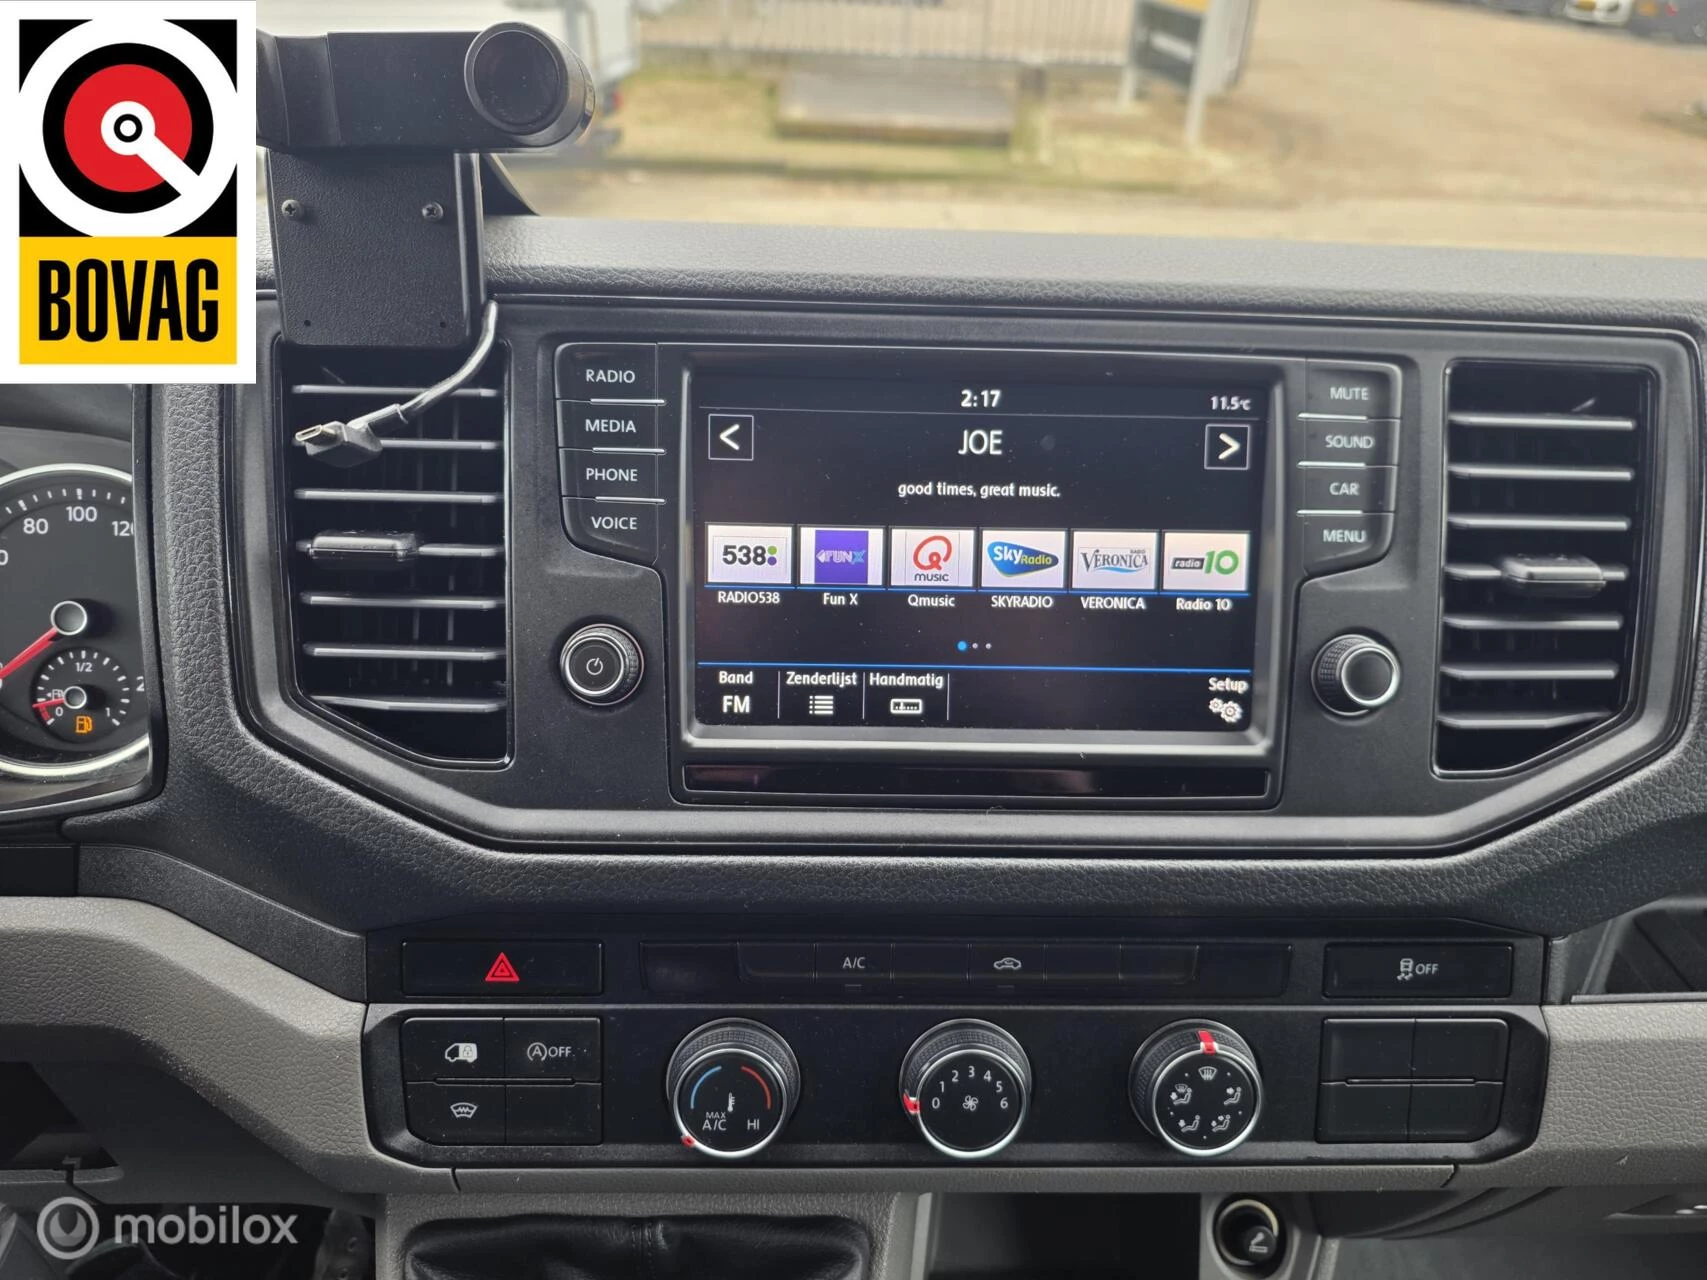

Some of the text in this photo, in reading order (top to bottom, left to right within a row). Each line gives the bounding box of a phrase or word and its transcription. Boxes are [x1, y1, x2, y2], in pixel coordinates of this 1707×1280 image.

[585, 369, 636, 383] RADIO
[960, 389, 1001, 408] 2:17
[1330, 387, 1369, 400] MUTE
[585, 419, 637, 433] MEDIA
[957, 429, 1003, 456] JOE
[1325, 435, 1375, 449] SOUND
[586, 468, 638, 482] PHONE
[897, 482, 1061, 500] good times, great music.
[1329, 482, 1360, 496] CAR
[66, 506, 98, 522] 100
[23, 518, 49, 535] 80
[591, 517, 638, 530] VOICE
[1323, 529, 1367, 543] MENU
[722, 544, 767, 565] 538
[993, 545, 1053, 565] Sky Radio
[1174, 549, 1240, 576] radio 10
[717, 590, 781, 605] RADIO538
[823, 592, 859, 606] Fun X
[907, 594, 956, 608] Qmusic
[990, 595, 1054, 609] SKYRADIO
[1080, 596, 1146, 610] VERONICA
[1175, 597, 1233, 611] Radio 10
[75, 662, 93, 673] 1/2
[718, 671, 754, 684] Band
[786, 671, 858, 687] Zenderlijst
[869, 672, 944, 689] Handmatig
[1208, 676, 1250, 694] Setup
[722, 695, 750, 713] FM
[55, 706, 64, 717] 0
[842, 956, 867, 970] A/C
[1415, 963, 1438, 975] OFF
[548, 1046, 572, 1058] OFF
[951, 1070, 960, 1082] 2
[968, 1065, 976, 1078] 3
[983, 1070, 993, 1082] 4
[939, 1081, 946, 1093] 1
[995, 1080, 1004, 1093] 5
[931, 1097, 941, 1110] 0
[1000, 1097, 1009, 1110] 6
[702, 1119, 728, 1132] A/C
[746, 1119, 761, 1130] HI
